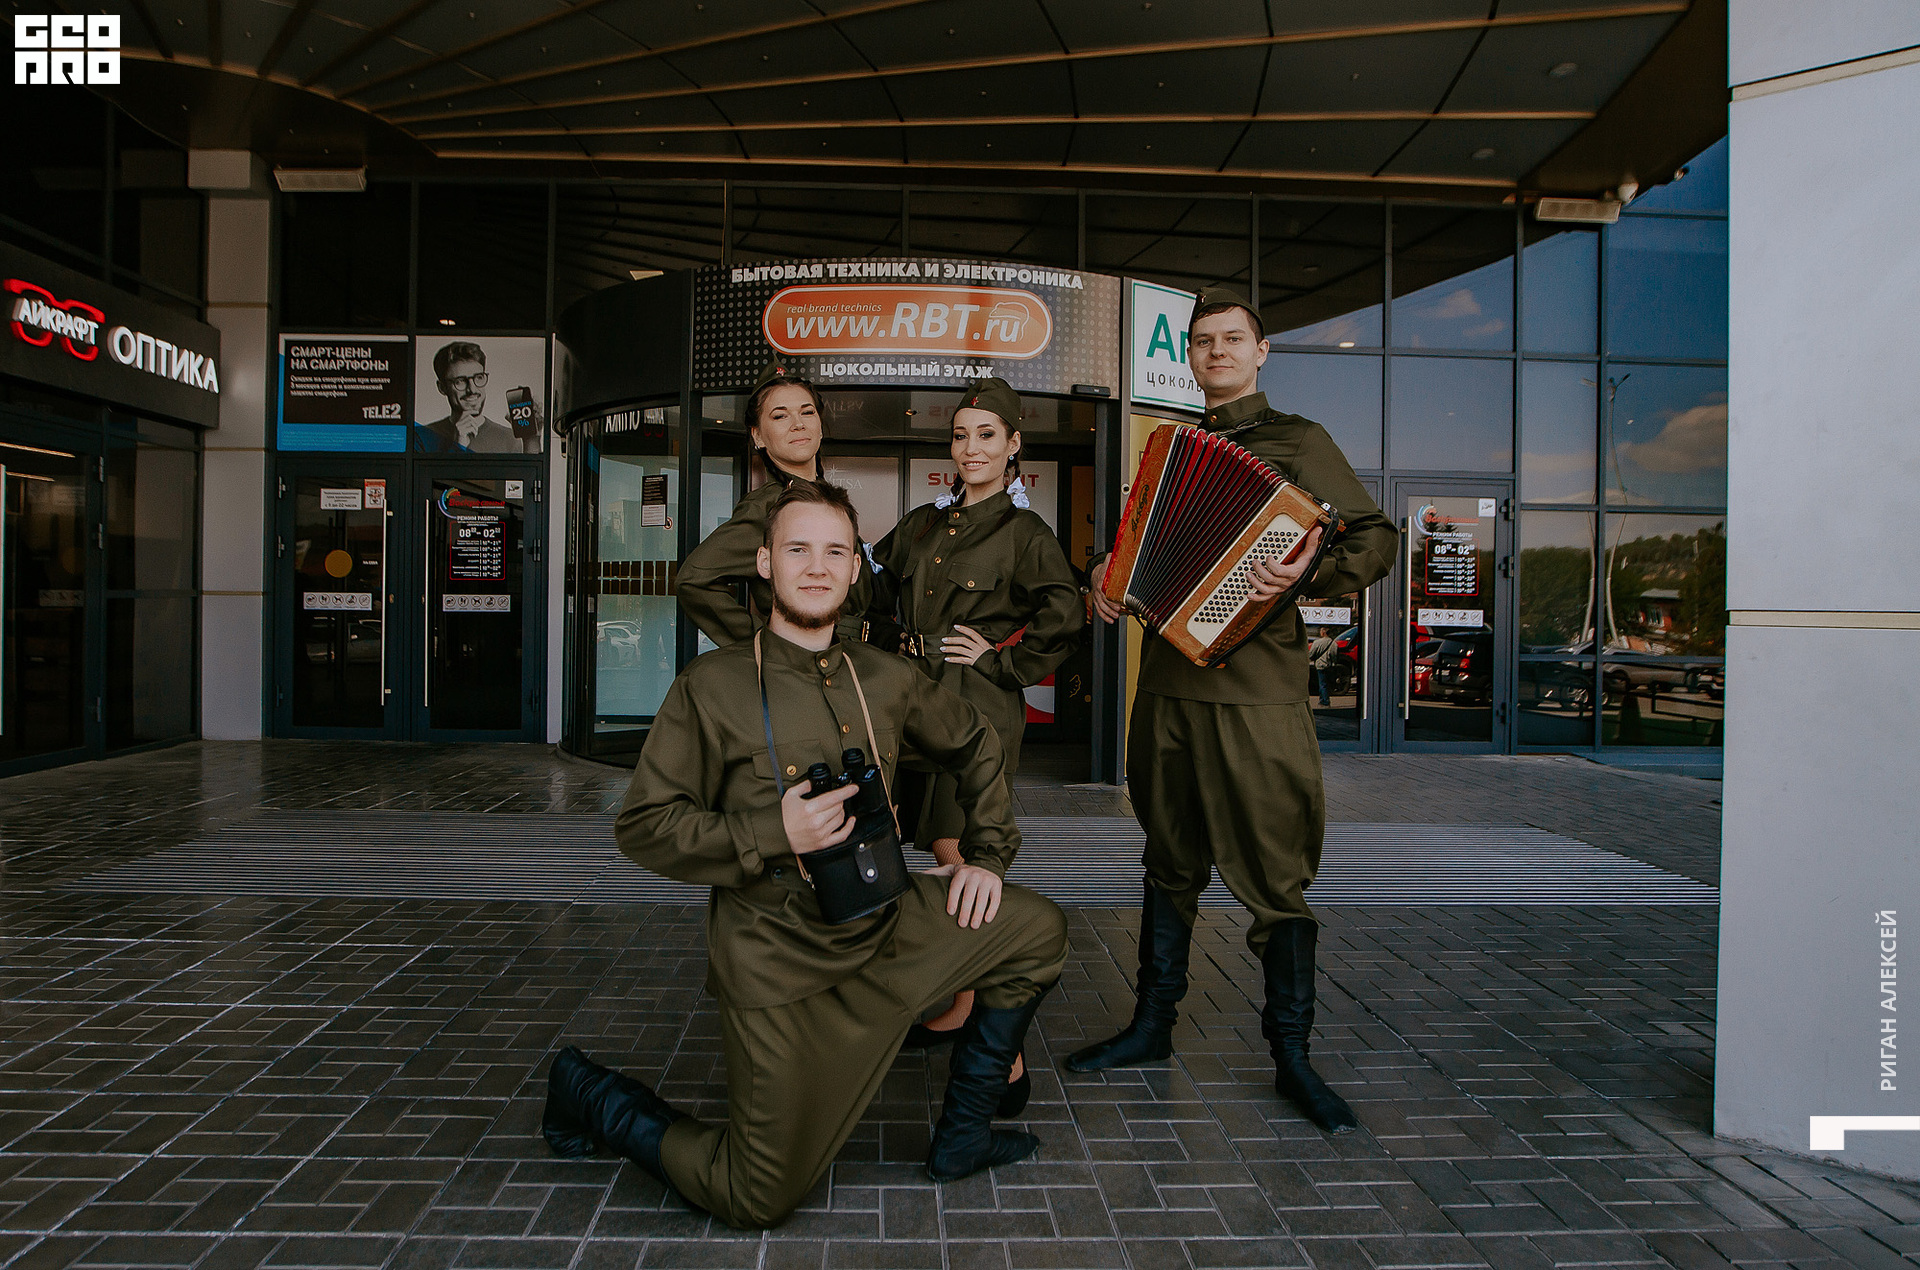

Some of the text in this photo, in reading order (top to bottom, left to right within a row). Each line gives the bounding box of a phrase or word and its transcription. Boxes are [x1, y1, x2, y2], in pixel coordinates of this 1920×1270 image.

[731, 262, 1084, 290] БЫТОВАЯ ТЕХНИКА И ЭЛЕКТРОНИКА
[786, 302, 883, 314] real brand technics
[786, 302, 1020, 343] www.RBT.ru
[12, 298, 219, 394] АЙКРАФТ ОПТИКА
[290, 345, 373, 360] СМАРТ-ЦЕНЫ
[290, 358, 389, 372] НА СМАРТФОНЫ
[820, 361, 994, 379] ЦОКОЛЬНЫЙ ЭТАЖ
[361, 402, 402, 420] TELE2
[511, 406, 532, 420] 20
